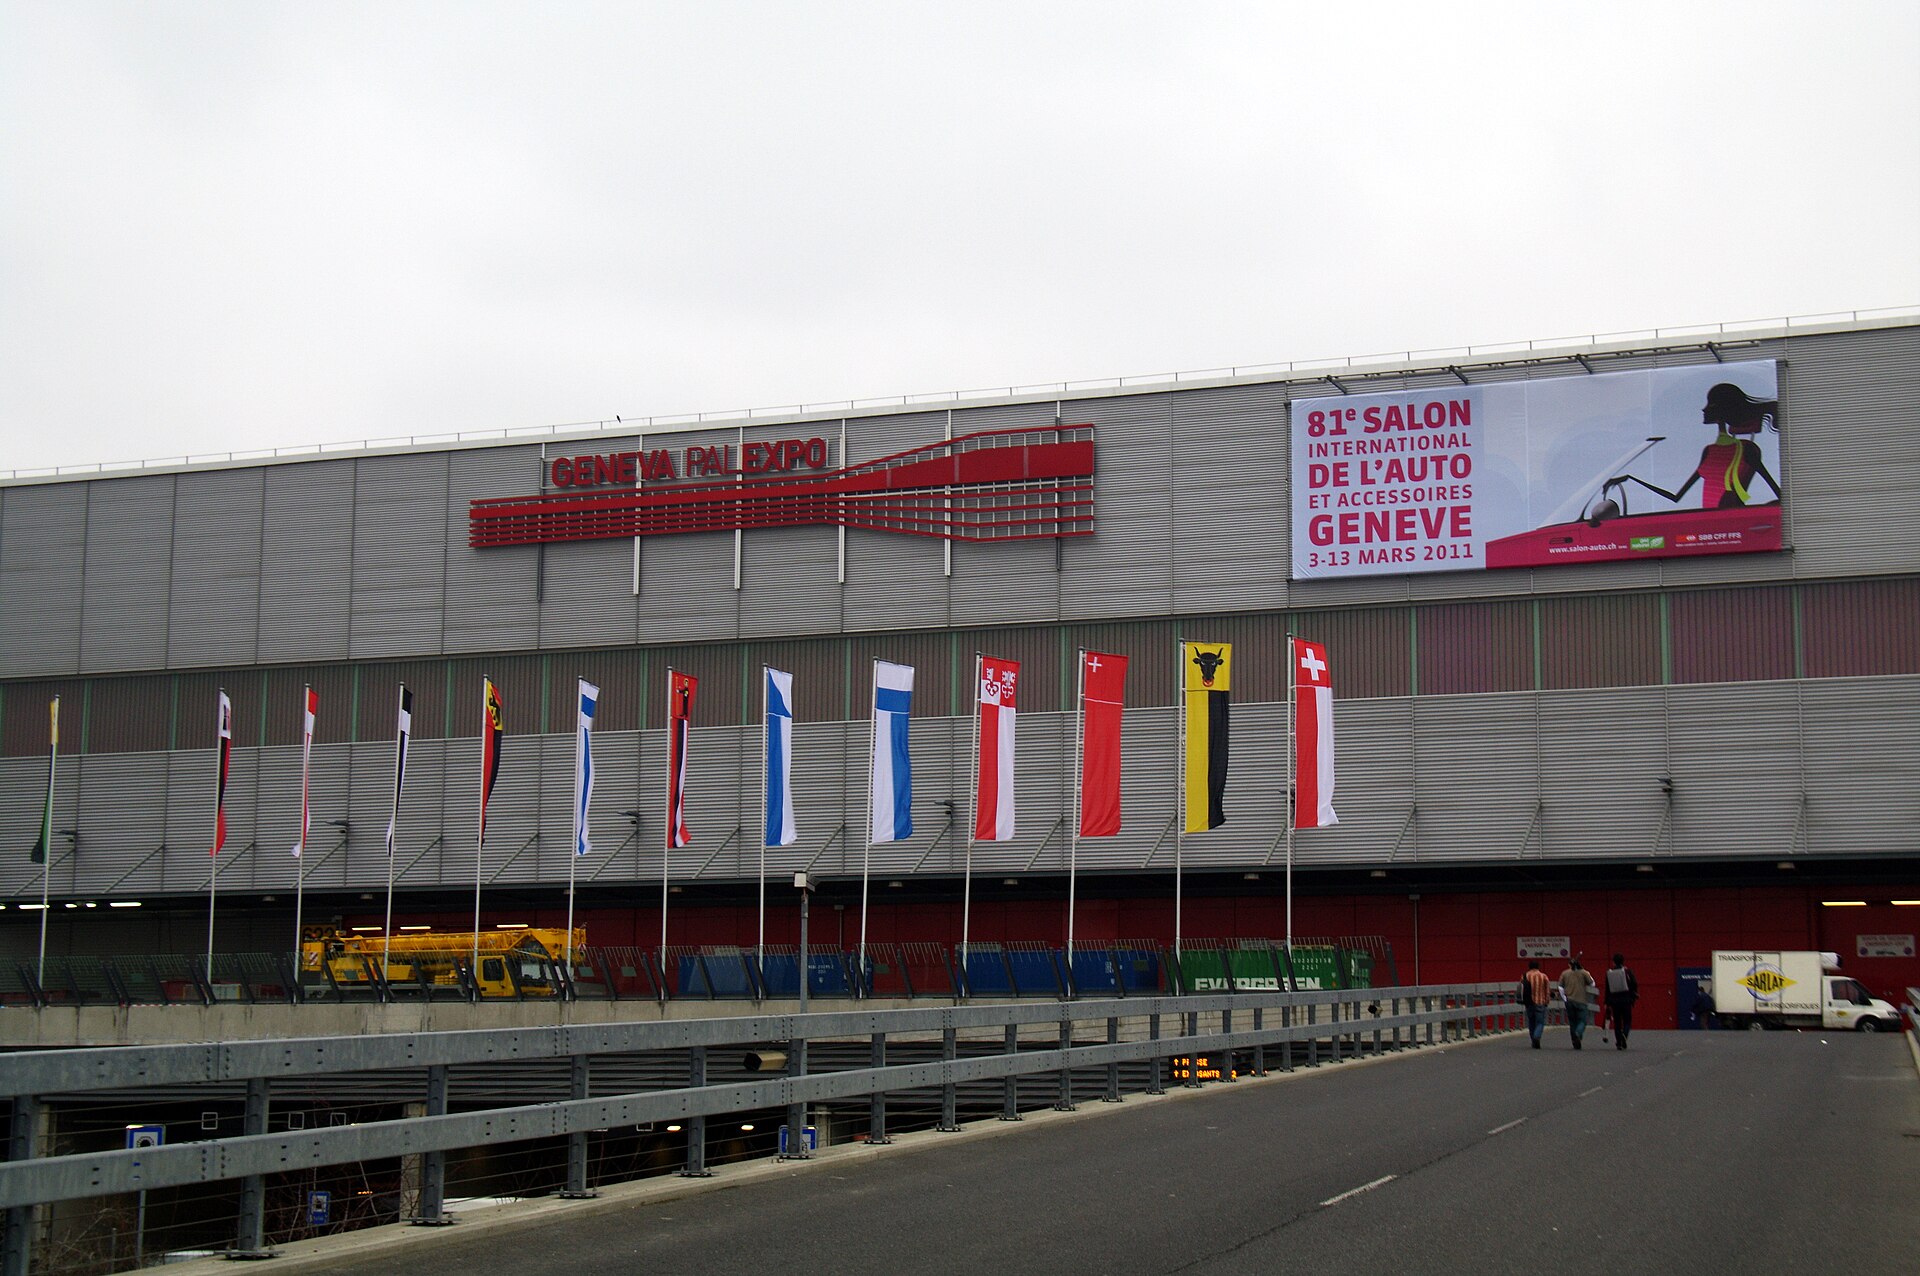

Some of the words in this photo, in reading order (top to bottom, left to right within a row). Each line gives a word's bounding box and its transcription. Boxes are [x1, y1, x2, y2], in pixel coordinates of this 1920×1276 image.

[1363, 399, 1471, 434] SALON
[1308, 432, 1472, 458] INTERNATIONAL
[551, 449, 676, 487] GENEVA
[1308, 461, 1350, 488] DE
[1360, 453, 1472, 486] L'AUTO
[1309, 494, 1331, 509] ET
[1337, 484, 1473, 508] ACCESSOIRES
[1308, 505, 1472, 546] GENEVE
[1309, 551, 1350, 567] 3-13
[1358, 547, 1416, 564] MARS
[1423, 543, 1473, 561] 2011
[1549, 543, 1617, 554] www.salon-auto.ch
[1747, 973, 1785, 992] SARLAT
